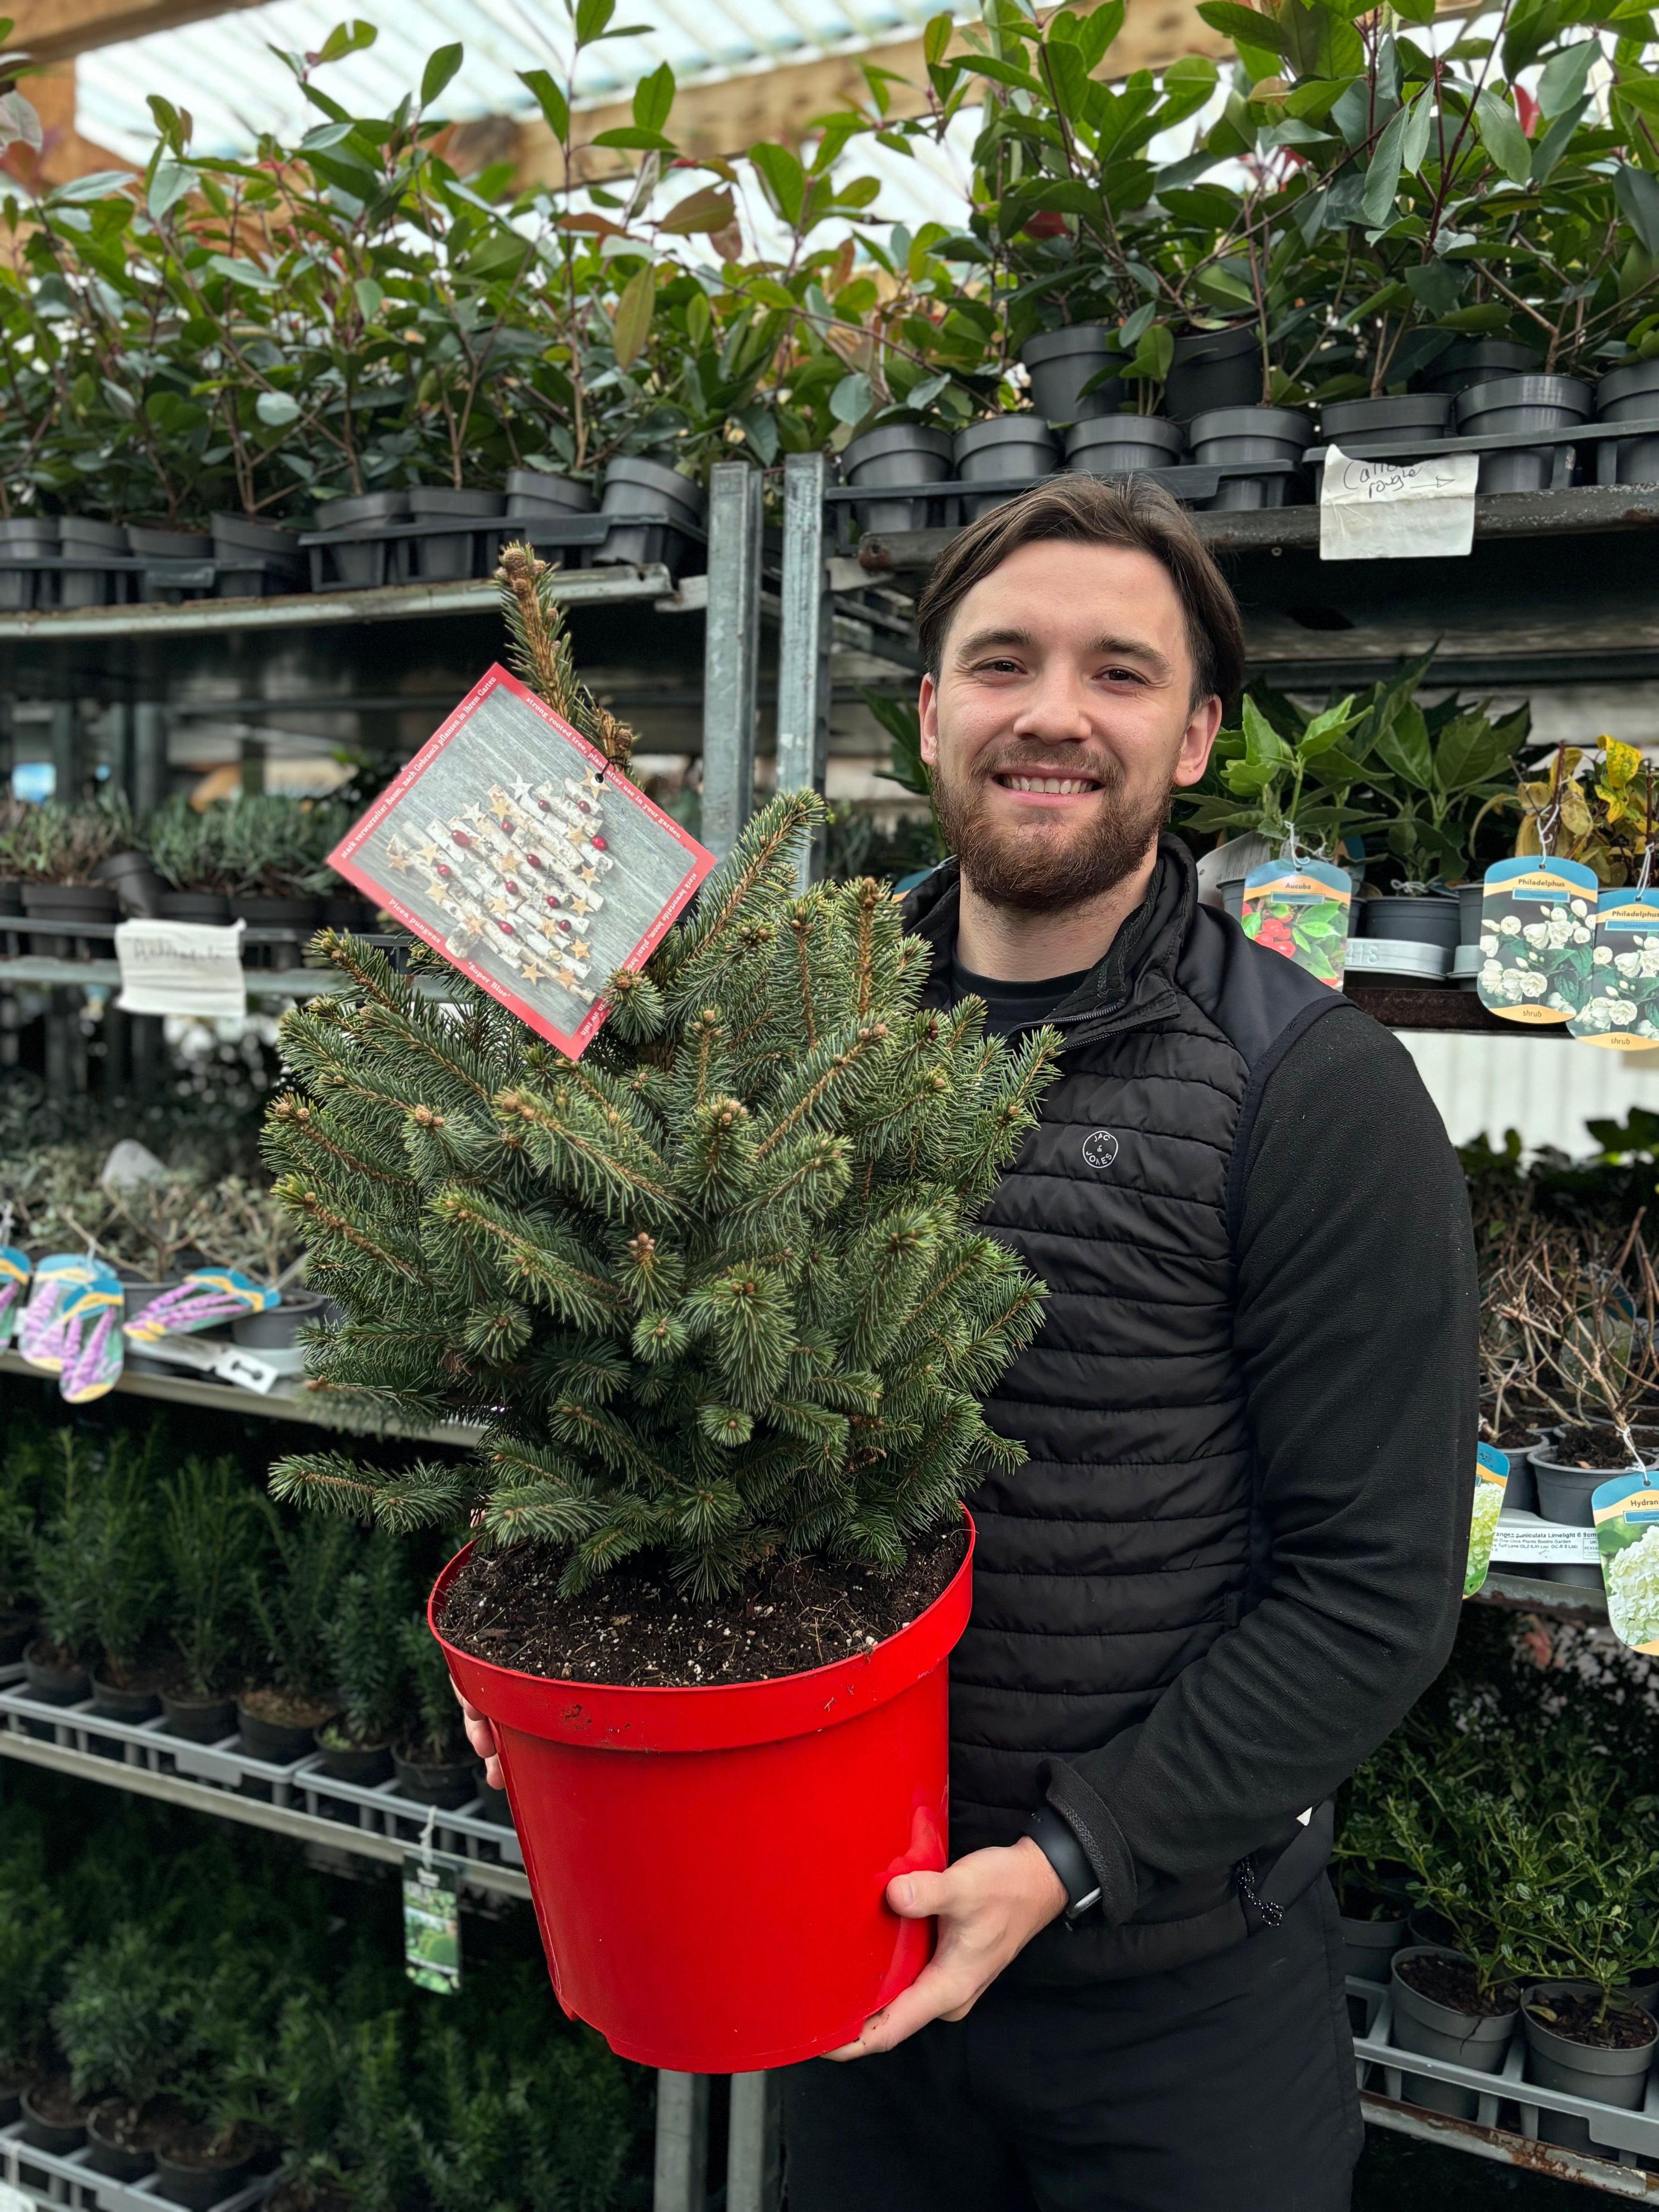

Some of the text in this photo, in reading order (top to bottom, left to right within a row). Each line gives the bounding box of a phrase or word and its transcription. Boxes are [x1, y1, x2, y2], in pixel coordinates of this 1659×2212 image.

[341, 841, 357, 858] stark
[355, 804, 388, 842] verwurzelter
[385, 788, 405, 806] Baum,
[402, 771, 417, 787] nach
[413, 744, 439, 771] Gebrauch
[438, 719, 461, 747] pflanzen
[463, 696, 481, 714] Ihrem
[477, 677, 496, 696] Garten
[526, 697, 681, 839] strong rooted tree, plant after use in your garden
[684, 872, 697, 890] sterk
[1518, 879, 1565, 887] Philadelphus
[661, 889, 688, 922] bewortelde
[1612, 910, 1659, 918] Philadelphus
[388, 899, 442, 944] Picea pungens
[648, 921, 665, 939] boom,
[636, 938, 650, 957] plant
[591, 1011, 600, 1023] uw
[580, 1022, 593, 1036] tuin
[1610, 1037, 1631, 1045] shrub
[1630, 1499, 1659, 1508] Hydran
